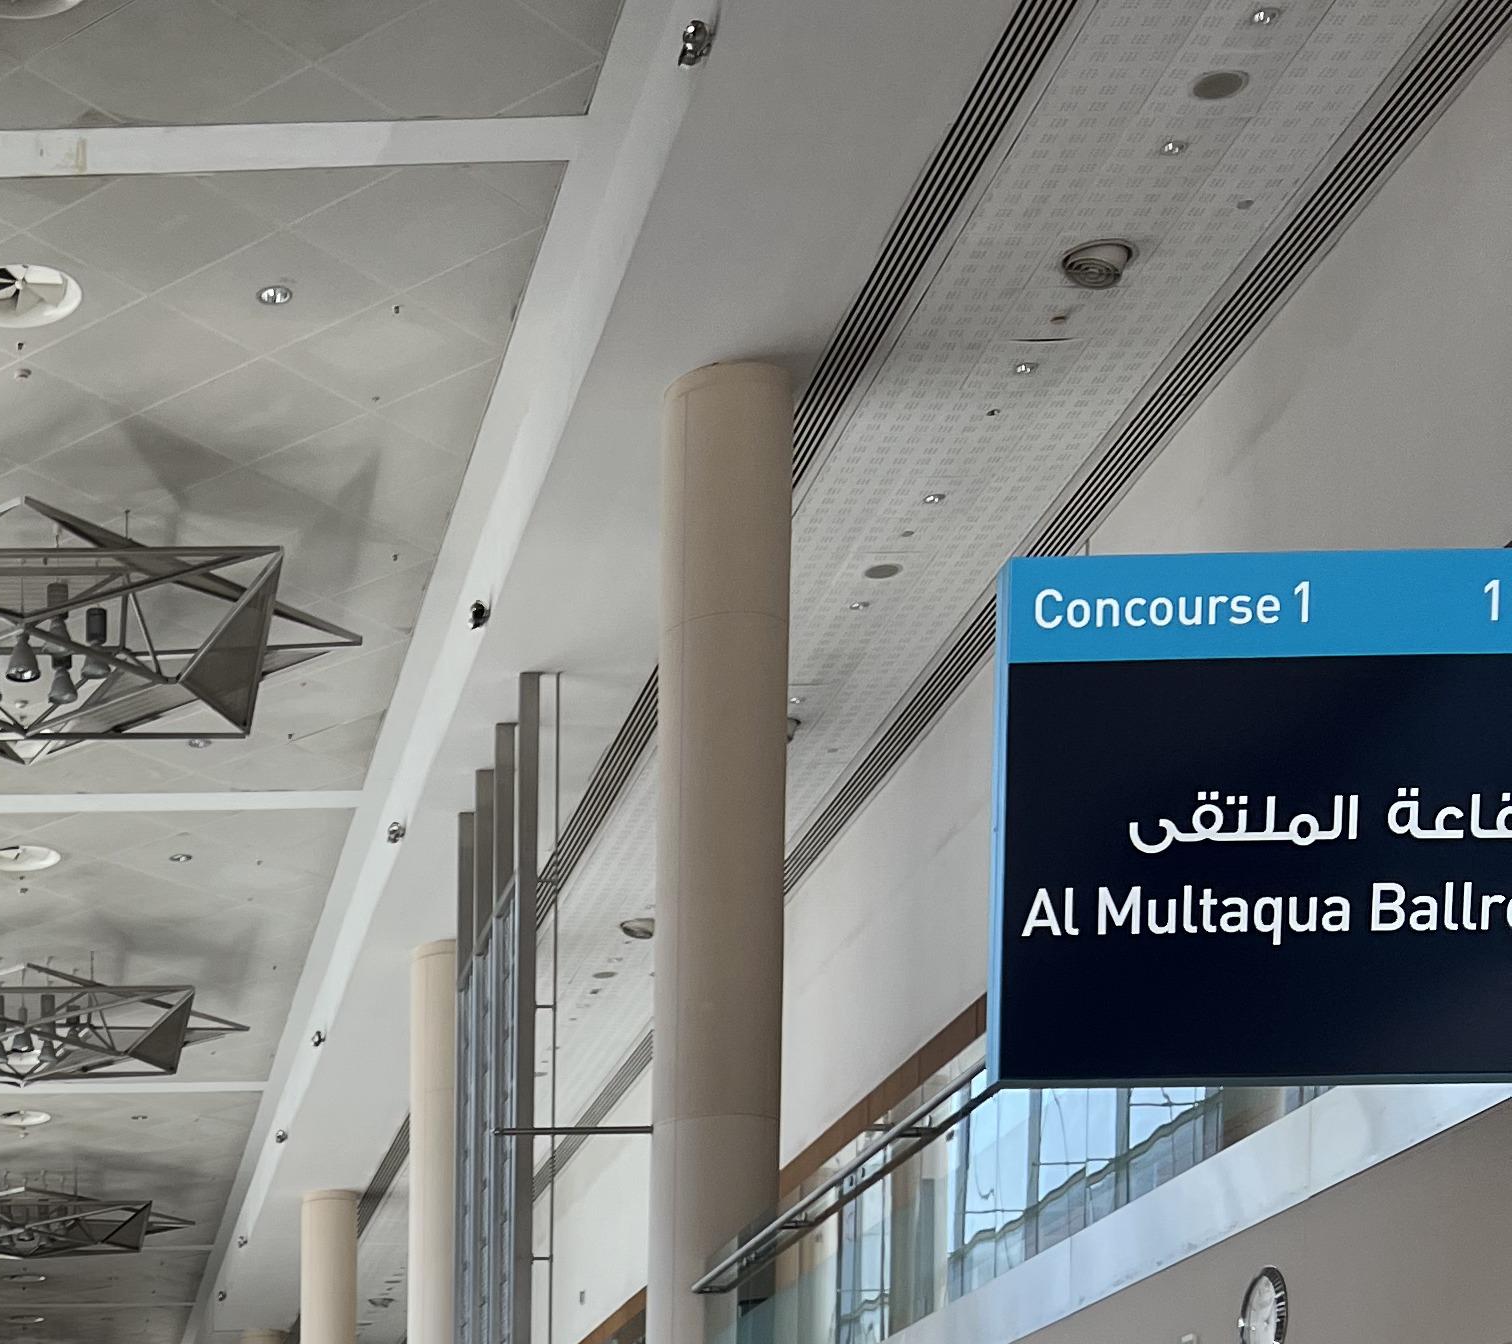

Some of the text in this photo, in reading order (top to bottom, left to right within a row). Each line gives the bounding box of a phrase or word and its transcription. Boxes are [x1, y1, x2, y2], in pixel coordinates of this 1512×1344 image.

[1034, 581, 1311, 630] Concourse 1
[1483, 579, 1501, 622] 1
[1128, 790, 1360, 855] الملتقى
[1021, 881, 1512, 946] Al Multaqua Ballr
